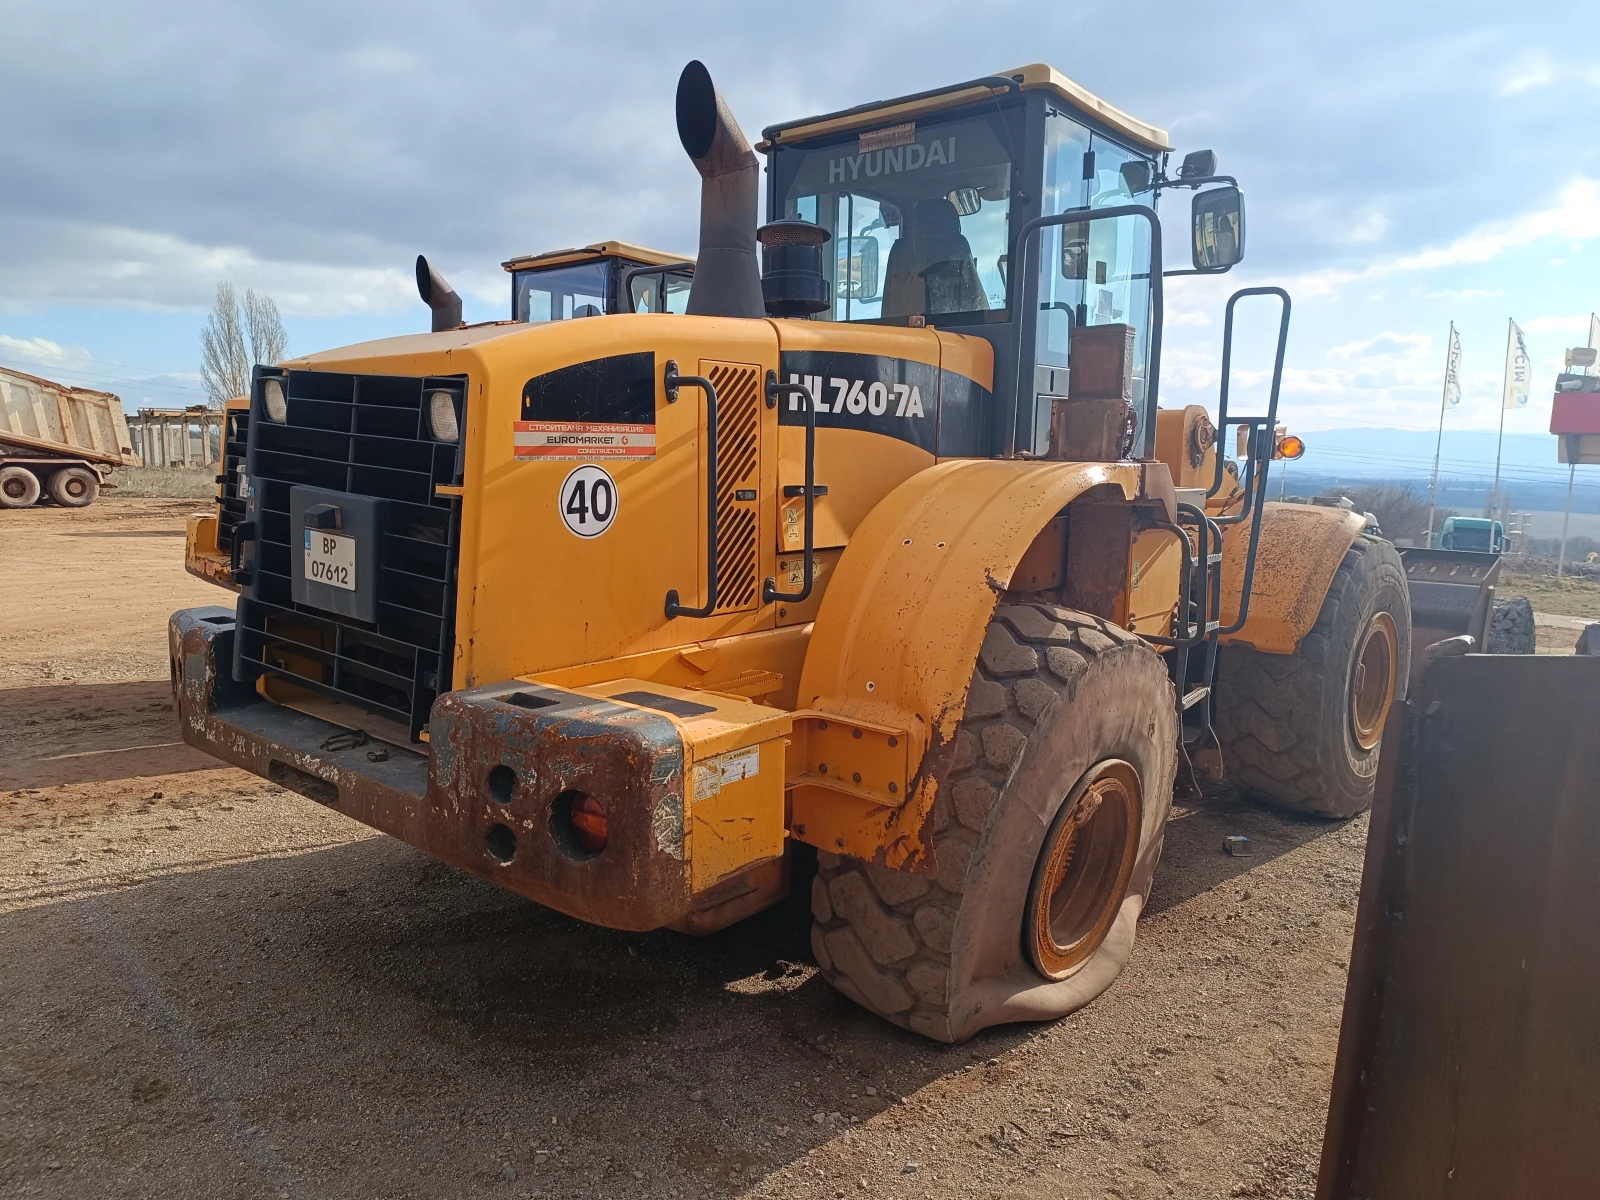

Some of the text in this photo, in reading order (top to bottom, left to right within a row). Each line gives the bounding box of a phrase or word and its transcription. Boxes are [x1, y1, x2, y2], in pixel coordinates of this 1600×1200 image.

[829, 137, 956, 184] HYUNDAI
[789, 373, 925, 418] HL760-7A
[528, 424, 644, 433] СТРОИТЕЛНА МЕХАНИЗАЦИЯ
[546, 436, 615, 444] EUROMARKET
[566, 478, 612, 524] 40
[323, 537, 336, 555] BP
[311, 560, 348, 585] 07612
